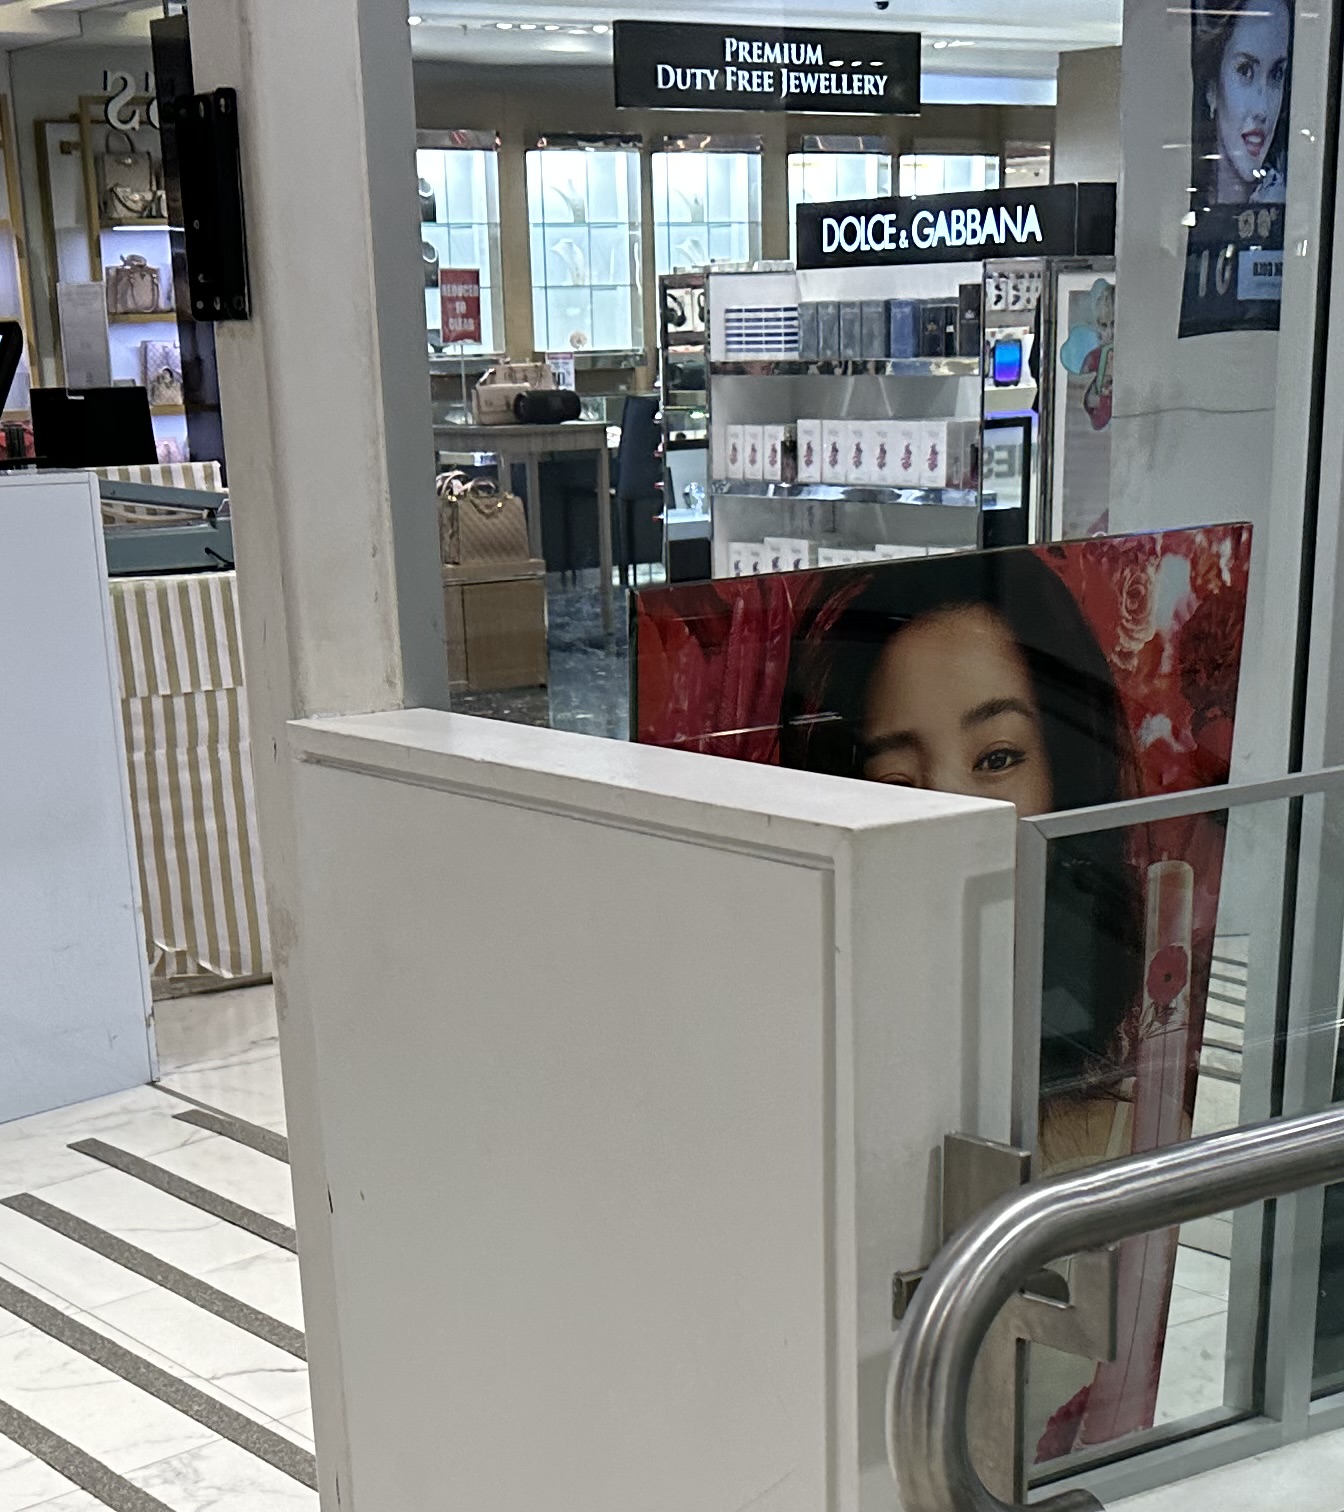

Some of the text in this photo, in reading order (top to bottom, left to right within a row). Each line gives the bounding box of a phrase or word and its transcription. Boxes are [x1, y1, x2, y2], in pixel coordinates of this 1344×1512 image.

[724, 38, 823, 66] PREMIUM
[656, 64, 888, 98] DUTY FREE JEWELLERY
